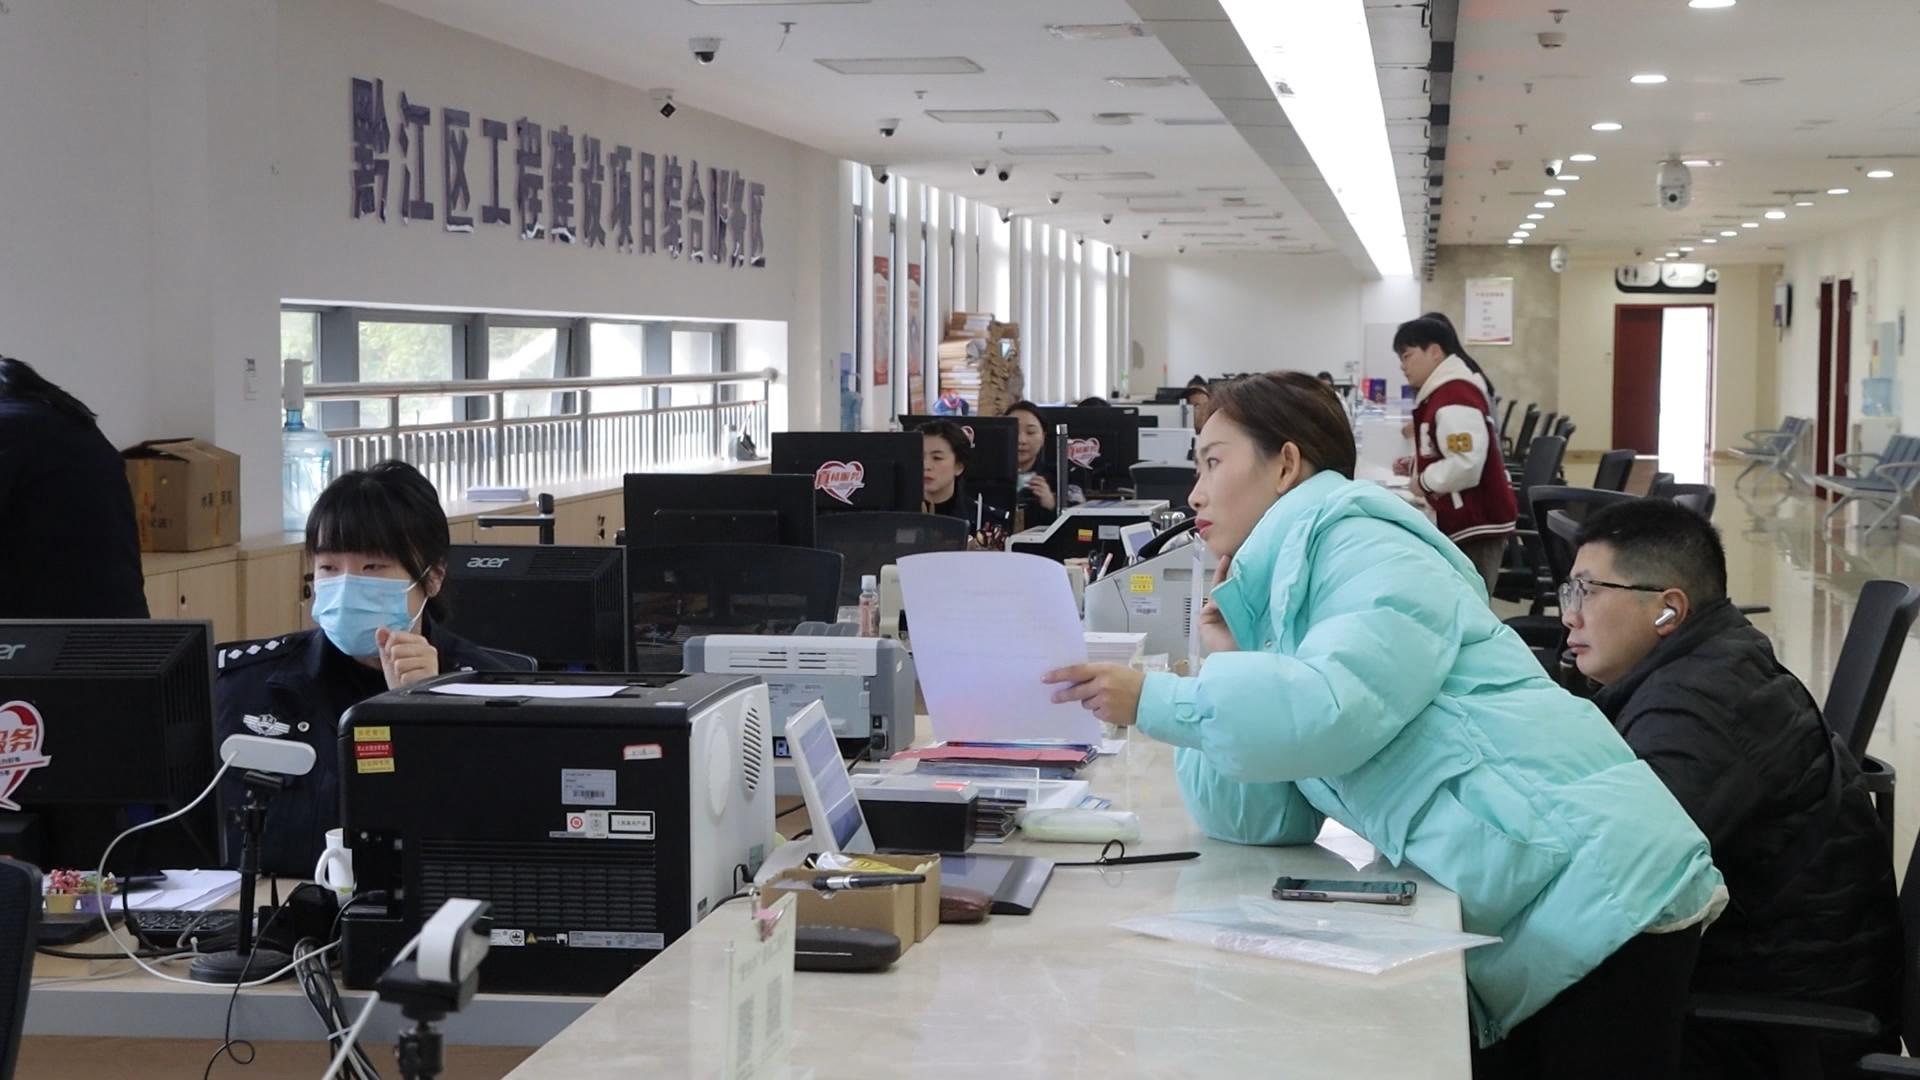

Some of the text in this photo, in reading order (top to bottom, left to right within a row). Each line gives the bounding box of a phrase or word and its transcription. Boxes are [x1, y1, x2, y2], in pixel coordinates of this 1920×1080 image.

[351, 77, 766, 268] 黔江区工程建设项目综合服务区
[467, 556, 510, 568] acer
